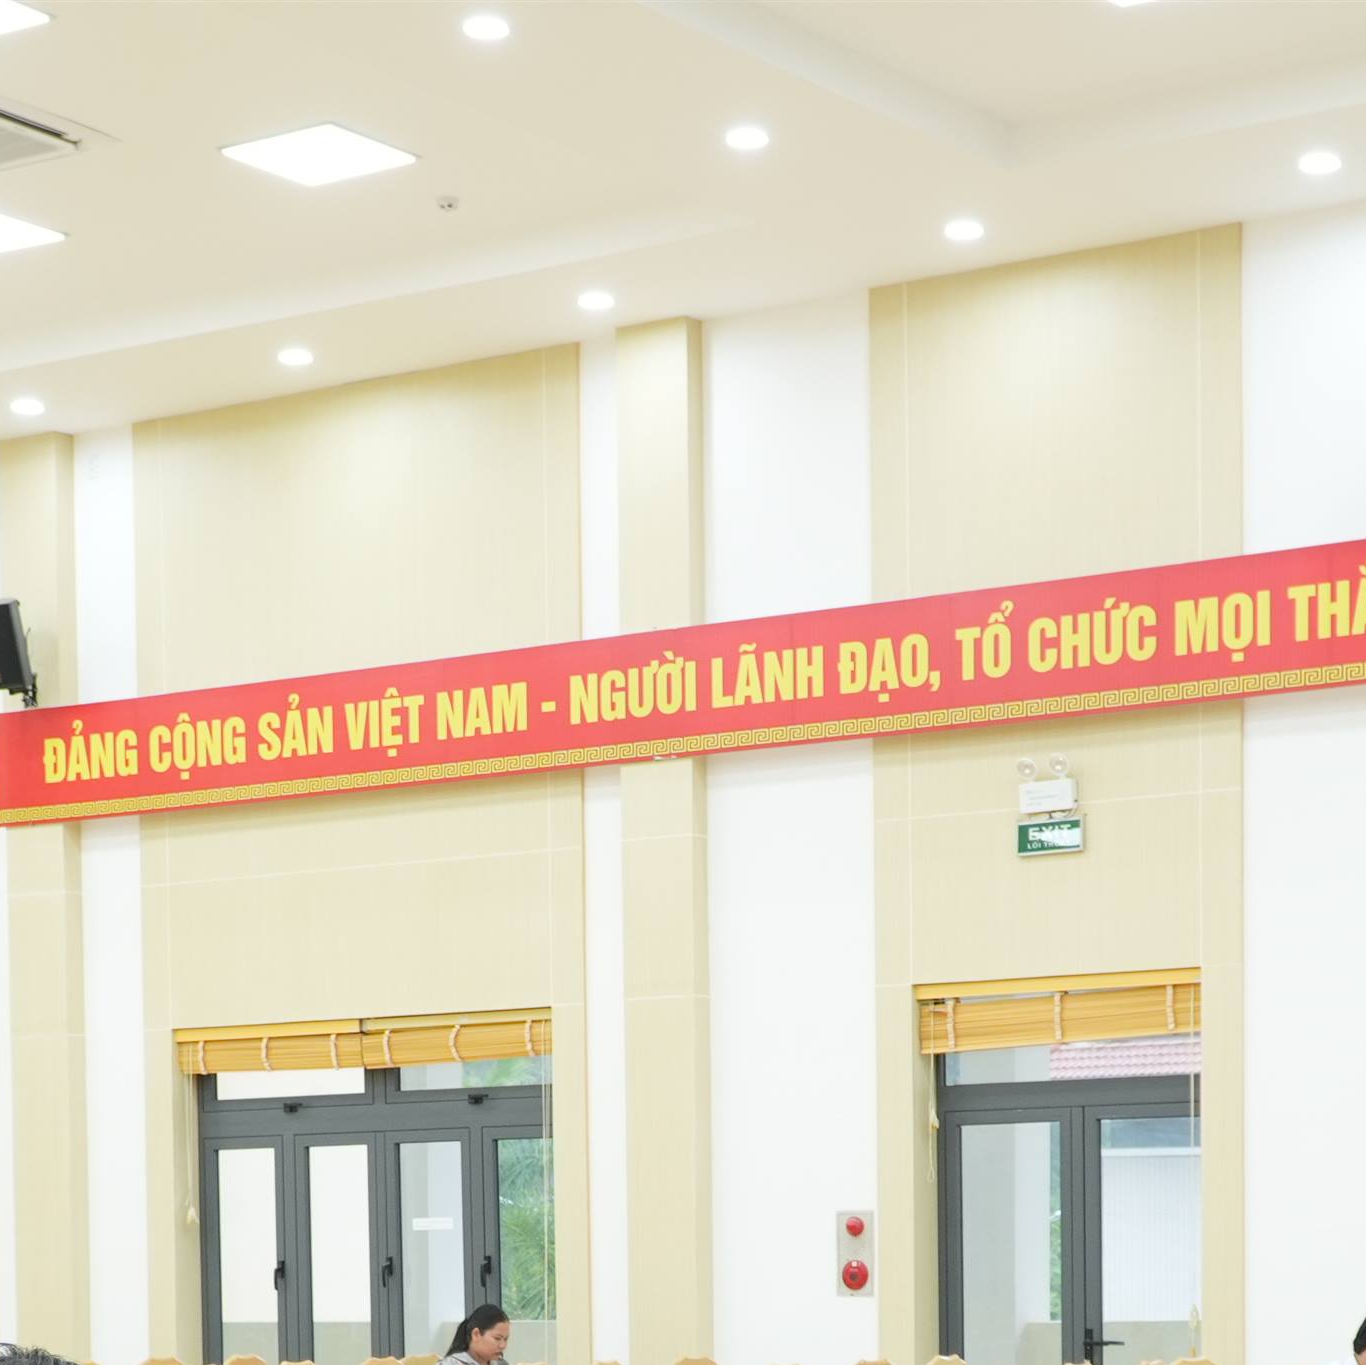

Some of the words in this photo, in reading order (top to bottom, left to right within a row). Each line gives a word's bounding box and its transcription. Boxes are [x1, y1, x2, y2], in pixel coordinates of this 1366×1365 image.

[44, 719, 139, 784] ĐẢNG
[150, 712, 247, 781] CỘNG
[257, 693, 334, 761] SẢN
[344, 687, 425, 757] VIỆT
[436, 682, 528, 740] NAM
[569, 650, 697, 725] NGƯỜI
[711, 643, 824, 709] LÃNH
[837, 627, 941, 703] ĐẠO,
[955, 600, 1015, 681] TỔ
[1028, 597, 1157, 673] CHỨC
[1174, 590, 1271, 662] MỌI
